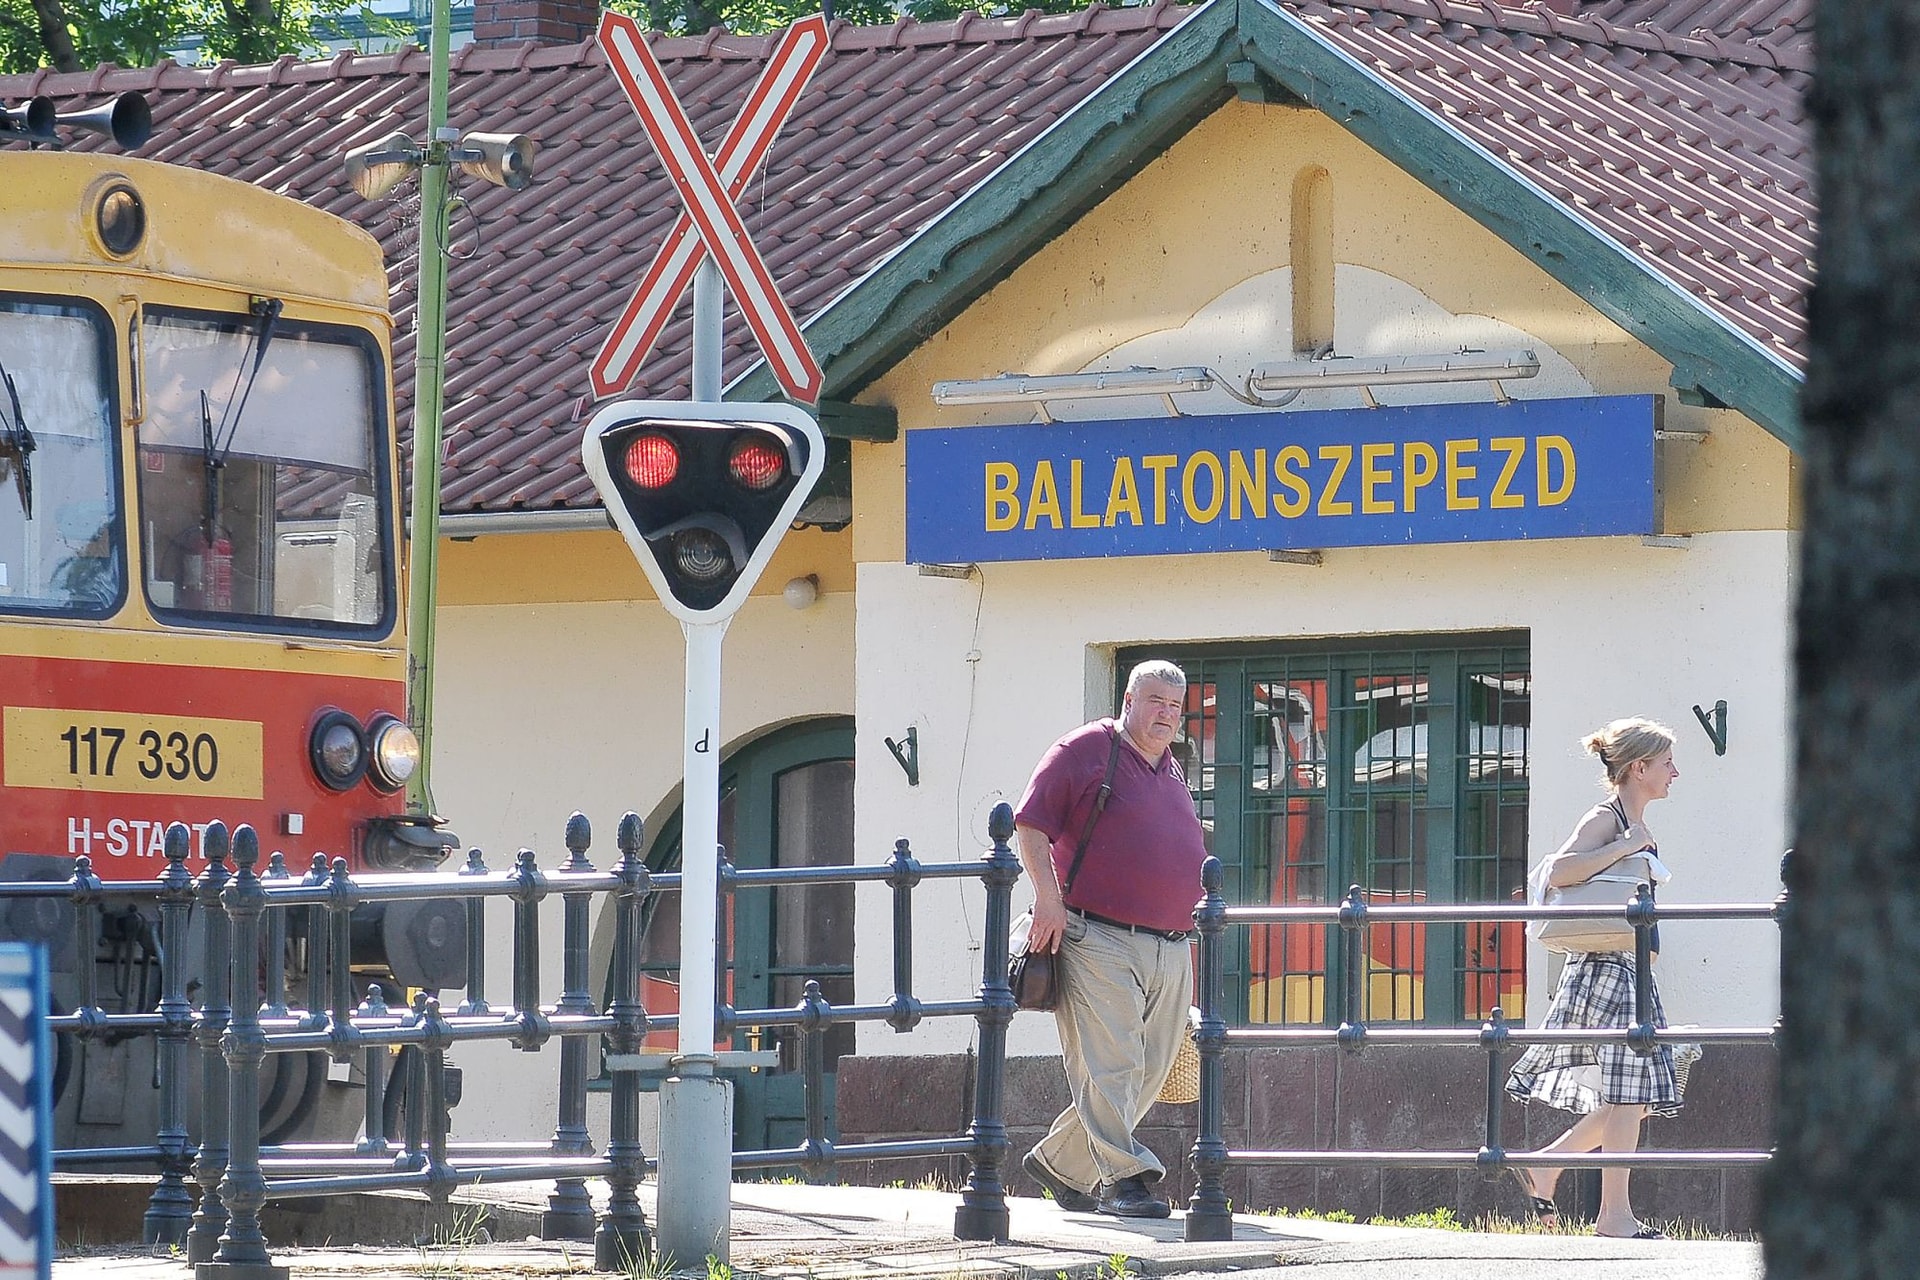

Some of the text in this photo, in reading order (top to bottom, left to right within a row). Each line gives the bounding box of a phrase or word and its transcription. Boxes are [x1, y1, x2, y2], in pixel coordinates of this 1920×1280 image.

[984, 434, 1577, 532] BALATONSZEPEZD
[60, 726, 218, 782] 117 330
[67, 817, 208, 859] H-STAT
